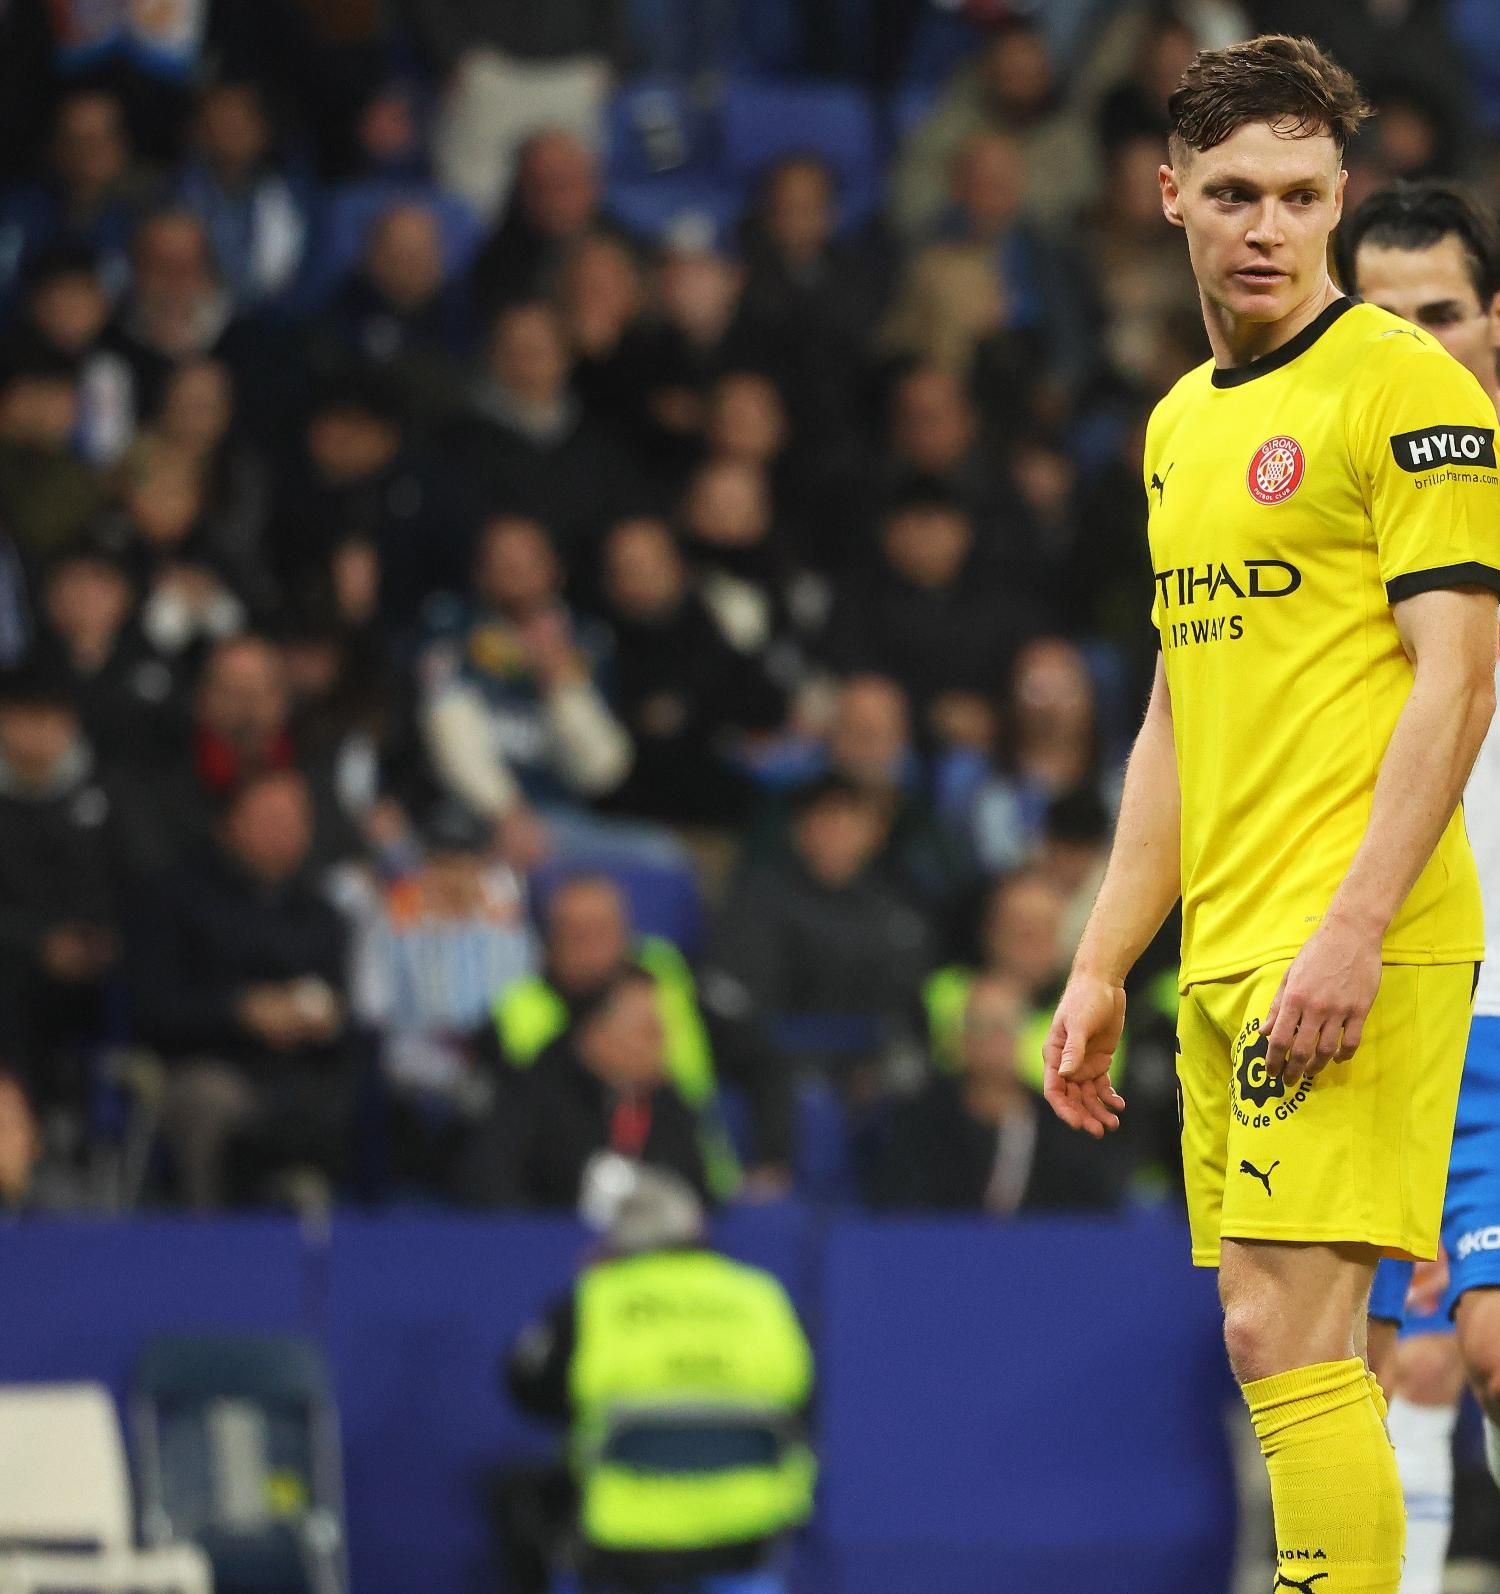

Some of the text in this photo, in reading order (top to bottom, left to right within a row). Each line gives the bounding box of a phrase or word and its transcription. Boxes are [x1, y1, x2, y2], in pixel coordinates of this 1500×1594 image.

[1261, 439, 1298, 457] GIRONA
[1414, 470, 1499, 489] brillpharma.com
[1155, 559, 1302, 609] TIHAD
[1168, 615, 1244, 649] IRWAYS
[1253, 1113, 1270, 1128] de
